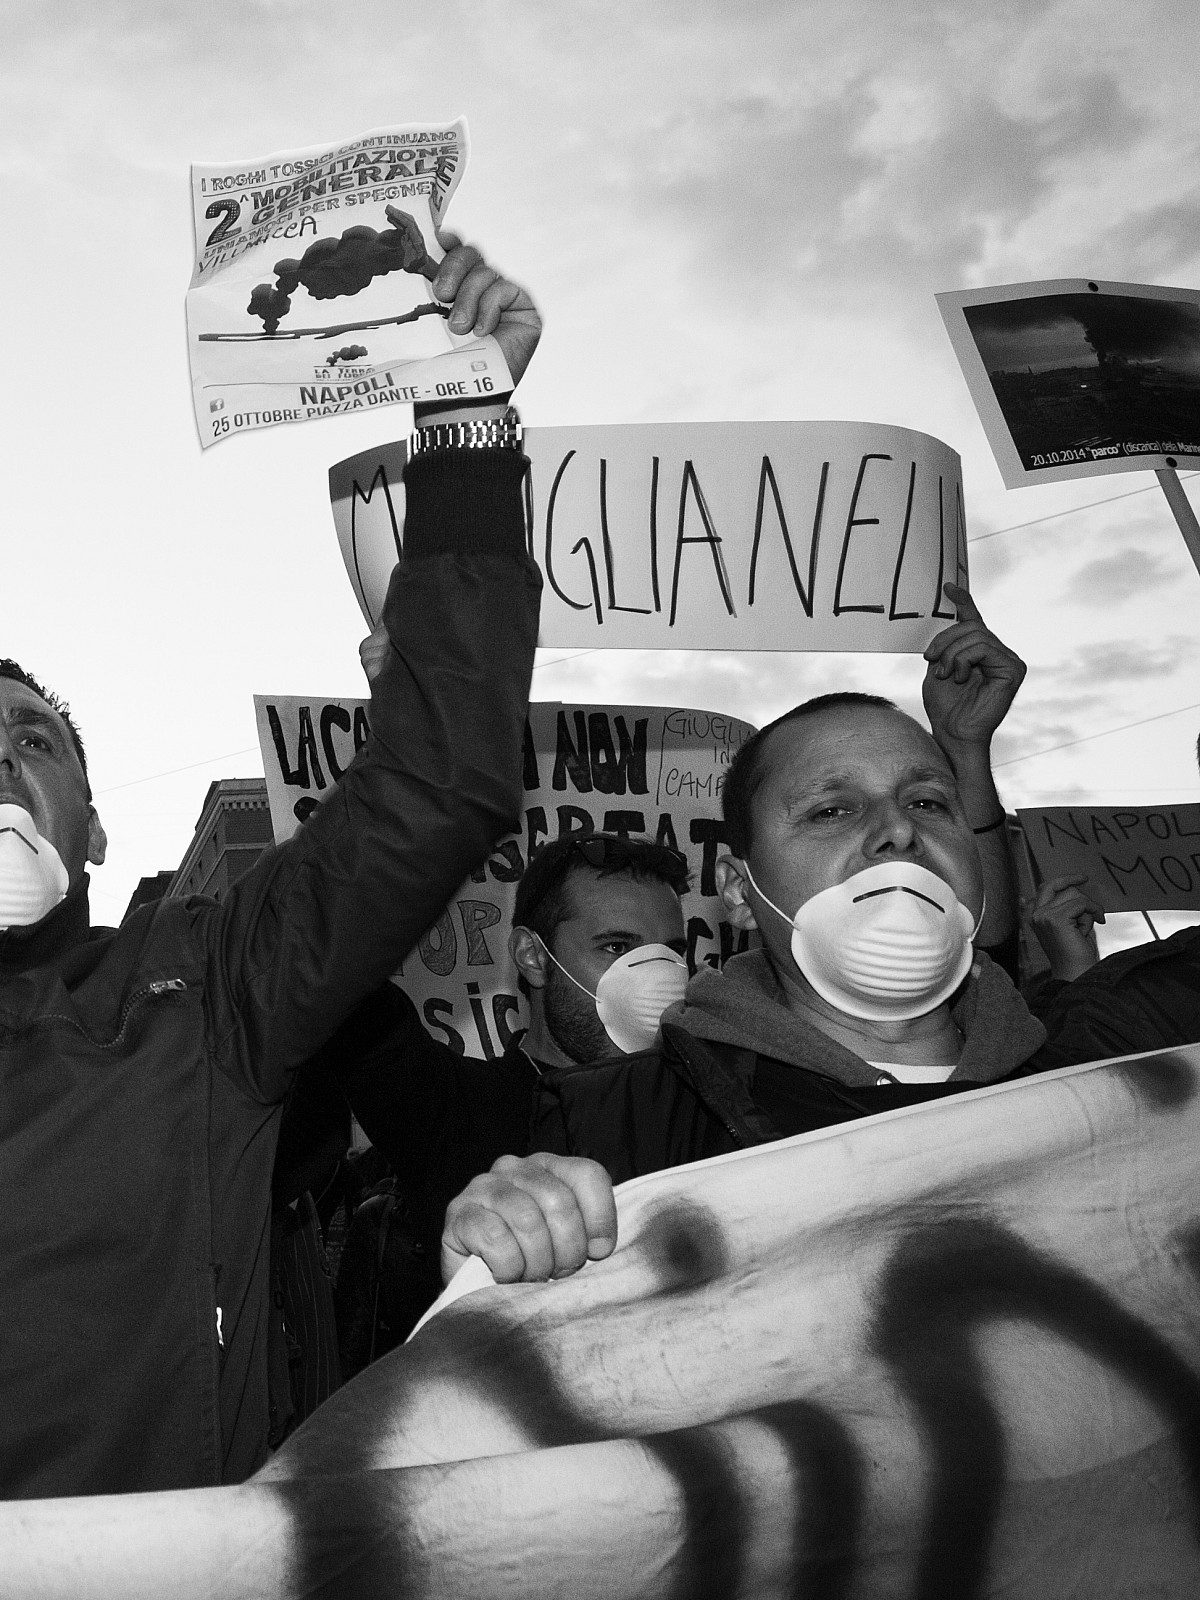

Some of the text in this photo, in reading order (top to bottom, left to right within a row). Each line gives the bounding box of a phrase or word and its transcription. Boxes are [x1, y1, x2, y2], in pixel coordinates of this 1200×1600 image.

[210, 168, 267, 192] ROGHI
[270, 152, 334, 179] TOSSICI
[338, 131, 457, 155] CONTINUANO
[251, 144, 459, 211] MOBILITAZIONE
[251, 155, 459, 226] GENERALE
[298, 196, 341, 216] PER
[212, 415, 230, 438] 25
[233, 408, 303, 428] OTTOBRE
[306, 396, 364, 418] PIAZZA
[366, 385, 421, 406] DANTE
[434, 381, 469, 397] ORE
[473, 376, 495, 393] 16
[299, 372, 395, 405] NAPOLI
[1030, 447, 1086, 466] 20.10.2014
